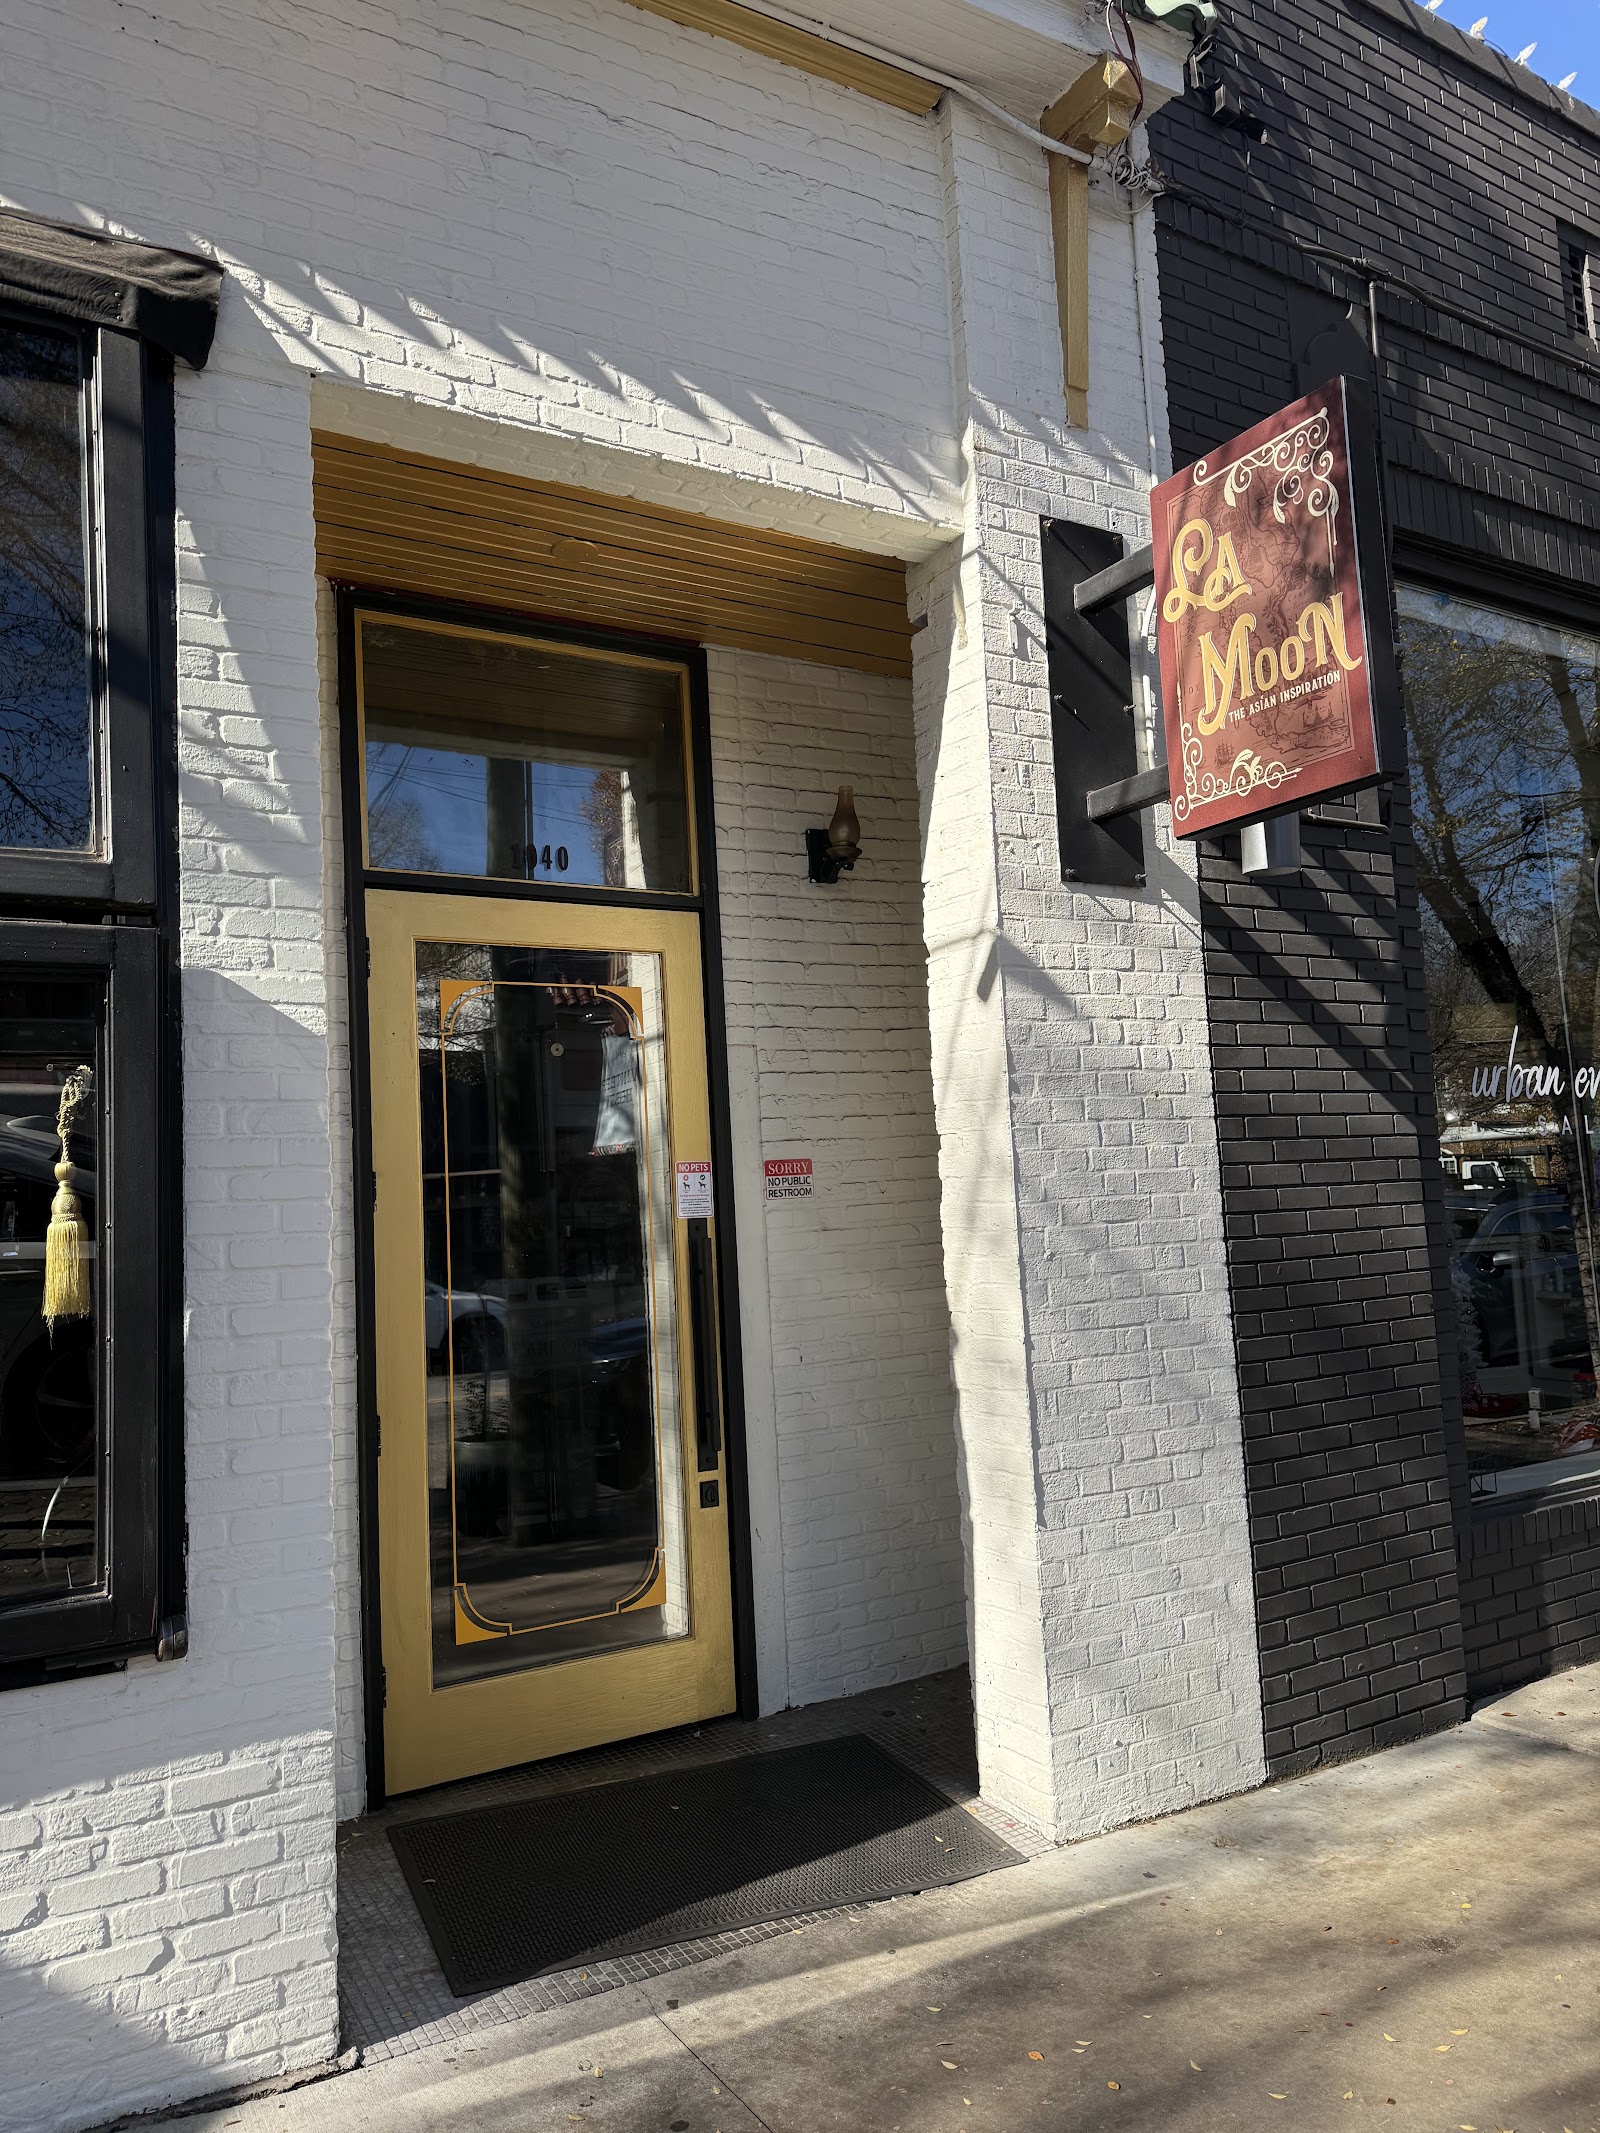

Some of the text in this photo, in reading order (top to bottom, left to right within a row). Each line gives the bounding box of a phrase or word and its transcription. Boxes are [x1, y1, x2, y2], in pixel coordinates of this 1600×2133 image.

[1163, 518, 1252, 623] LA
[1229, 670, 1341, 723] THE ASIAN INSPIRATION
[1472, 1025, 1565, 1103] urban
[1539, 1114, 1595, 1137] SAL
[678, 1163, 709, 1172] NO PETS
[768, 1161, 809, 1174] SORRY
[768, 1176, 811, 1186] NO PUBLIC
[768, 1187, 812, 1198] RESTROOM
